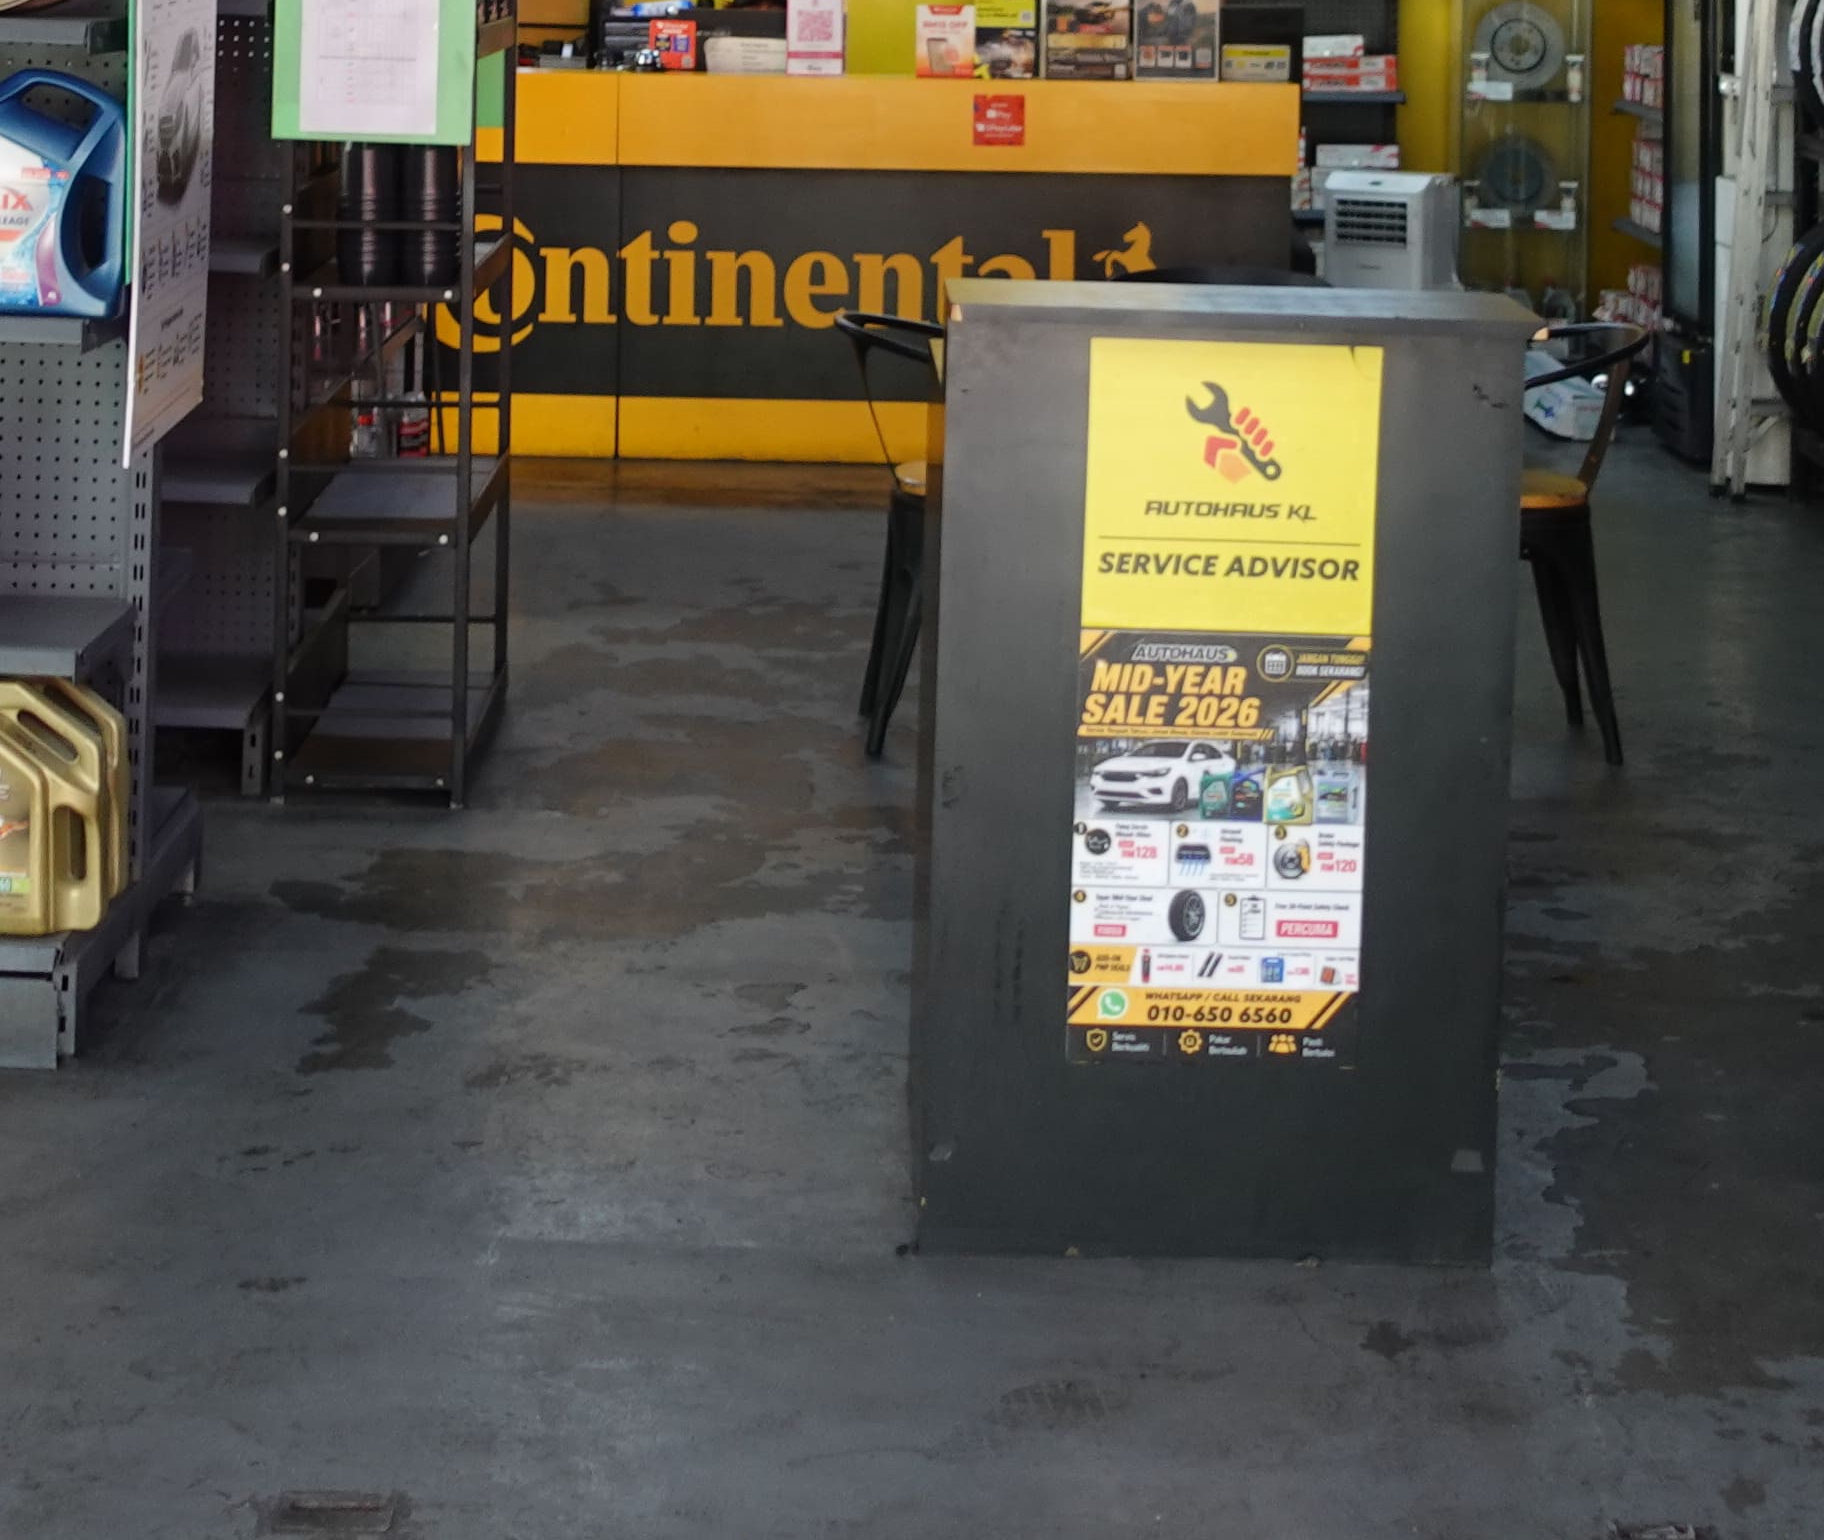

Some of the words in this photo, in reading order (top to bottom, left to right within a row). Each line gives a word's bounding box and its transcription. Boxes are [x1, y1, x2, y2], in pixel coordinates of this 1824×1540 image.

[1144, 499, 1282, 520] AUTOHAUS
[1285, 503, 1318, 523] KL
[1098, 552, 1220, 577] SERVICE
[1224, 555, 1360, 581] ADVISOR
[1134, 644, 1230, 661] AUTOHAUS
[1090, 662, 1248, 695] MID-YEAR
[1082, 693, 1168, 726] SALE
[1174, 696, 1261, 728] 2026
[1279, 922, 1333, 936] PERCUMA
[1145, 992, 1203, 1002] WHATSAPP
[1213, 993, 1239, 1003] CALL
[1243, 994, 1302, 1004] SEKARANG
[1146, 1005, 1233, 1023] 010-650
[1239, 1006, 1293, 1024] 6560
